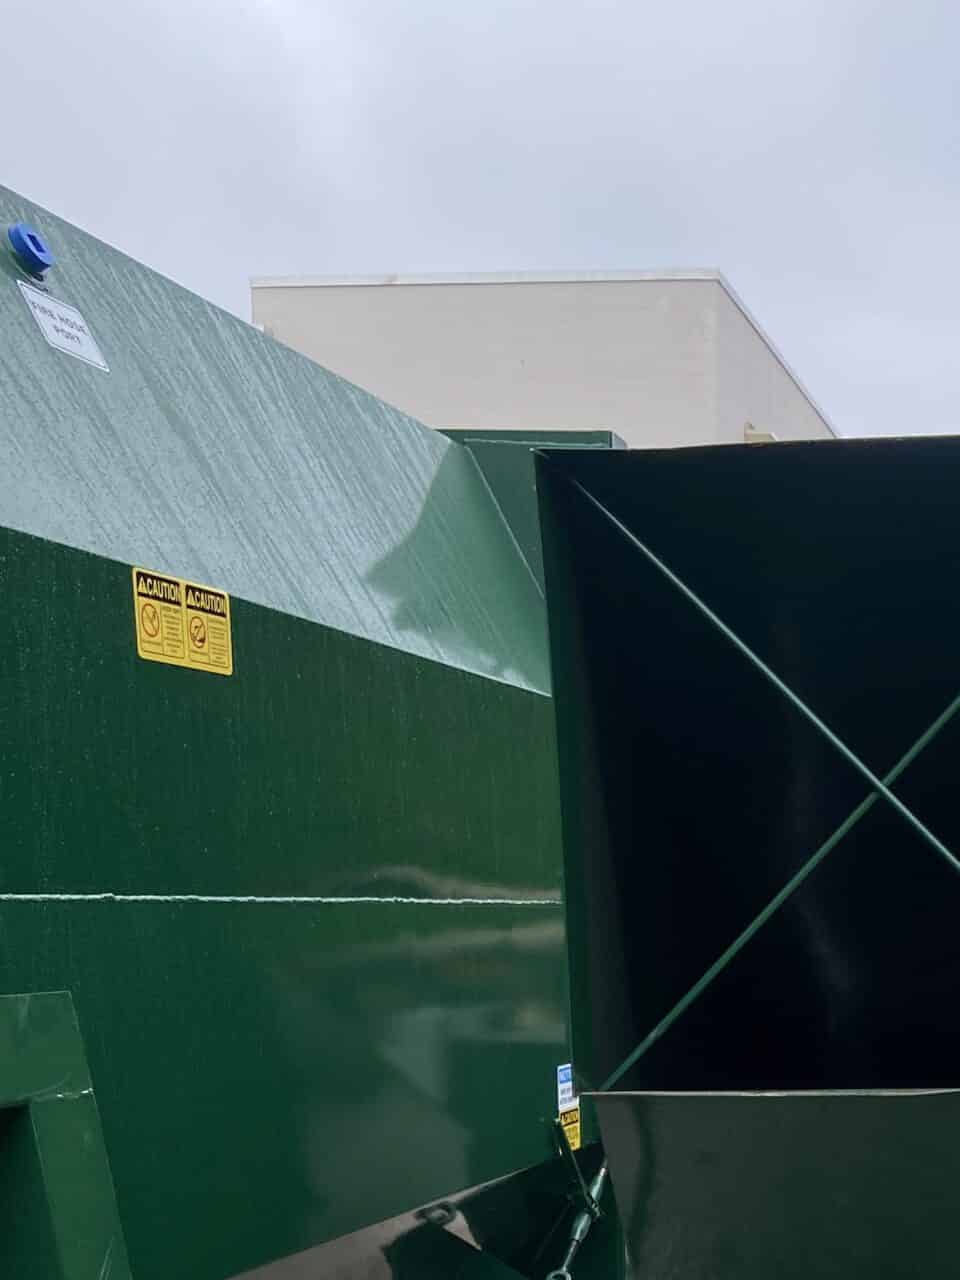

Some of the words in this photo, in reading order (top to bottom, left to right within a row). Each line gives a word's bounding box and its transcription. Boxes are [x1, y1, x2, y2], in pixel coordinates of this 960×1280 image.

[31, 301, 57, 321] FIRE
[57, 312, 87, 336] HOSE
[53, 325, 81, 344] PORT
[147, 577, 180, 603] CAUTION
[195, 591, 227, 614] CAUTION
